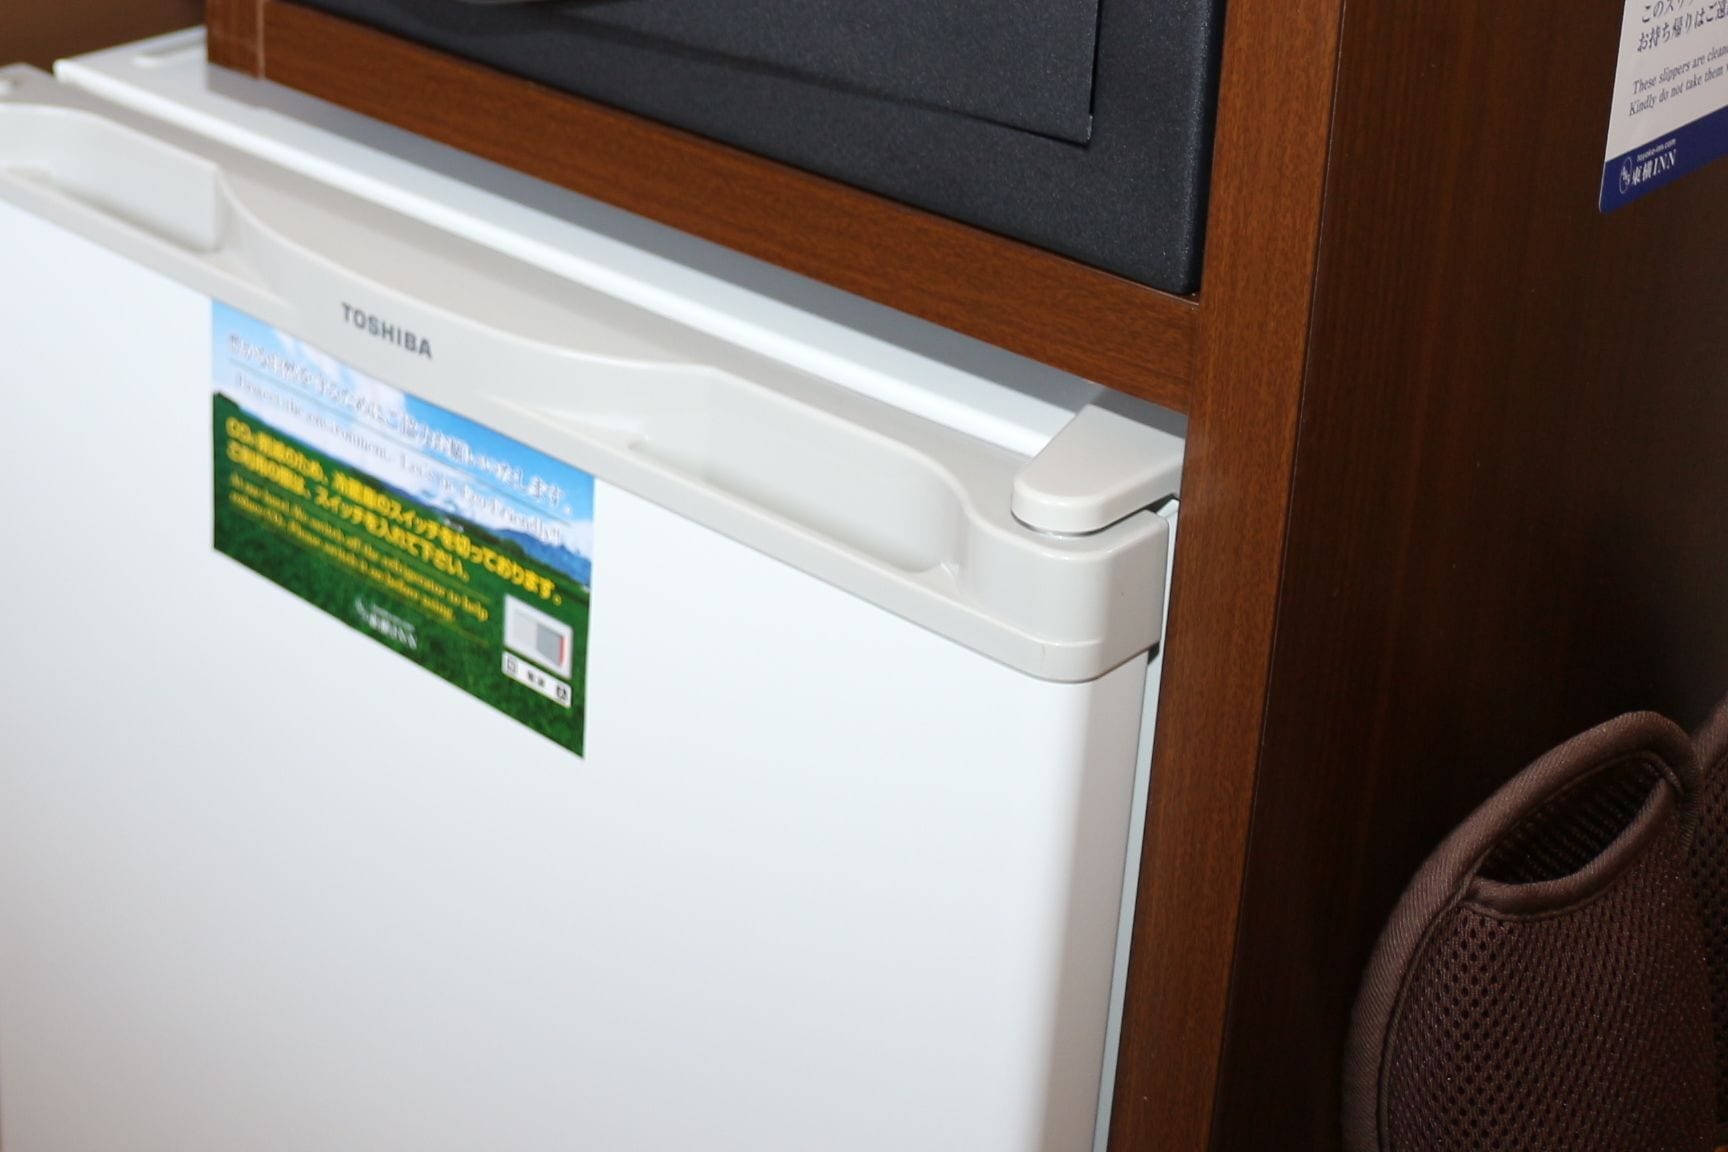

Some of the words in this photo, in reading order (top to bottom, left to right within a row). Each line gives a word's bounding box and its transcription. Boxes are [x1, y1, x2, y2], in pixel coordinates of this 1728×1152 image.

[1629, 93, 1657, 116] Kindly
[1659, 89, 1669, 103] do
[1670, 83, 1684, 98] not
[1685, 73, 1702, 91] take
[1704, 66, 1724, 82] them
[1633, 76, 1657, 95] These
[1659, 62, 1690, 85] slippers
[1692, 55, 1706, 68] are
[341, 301, 432, 359] TOSHIBA
